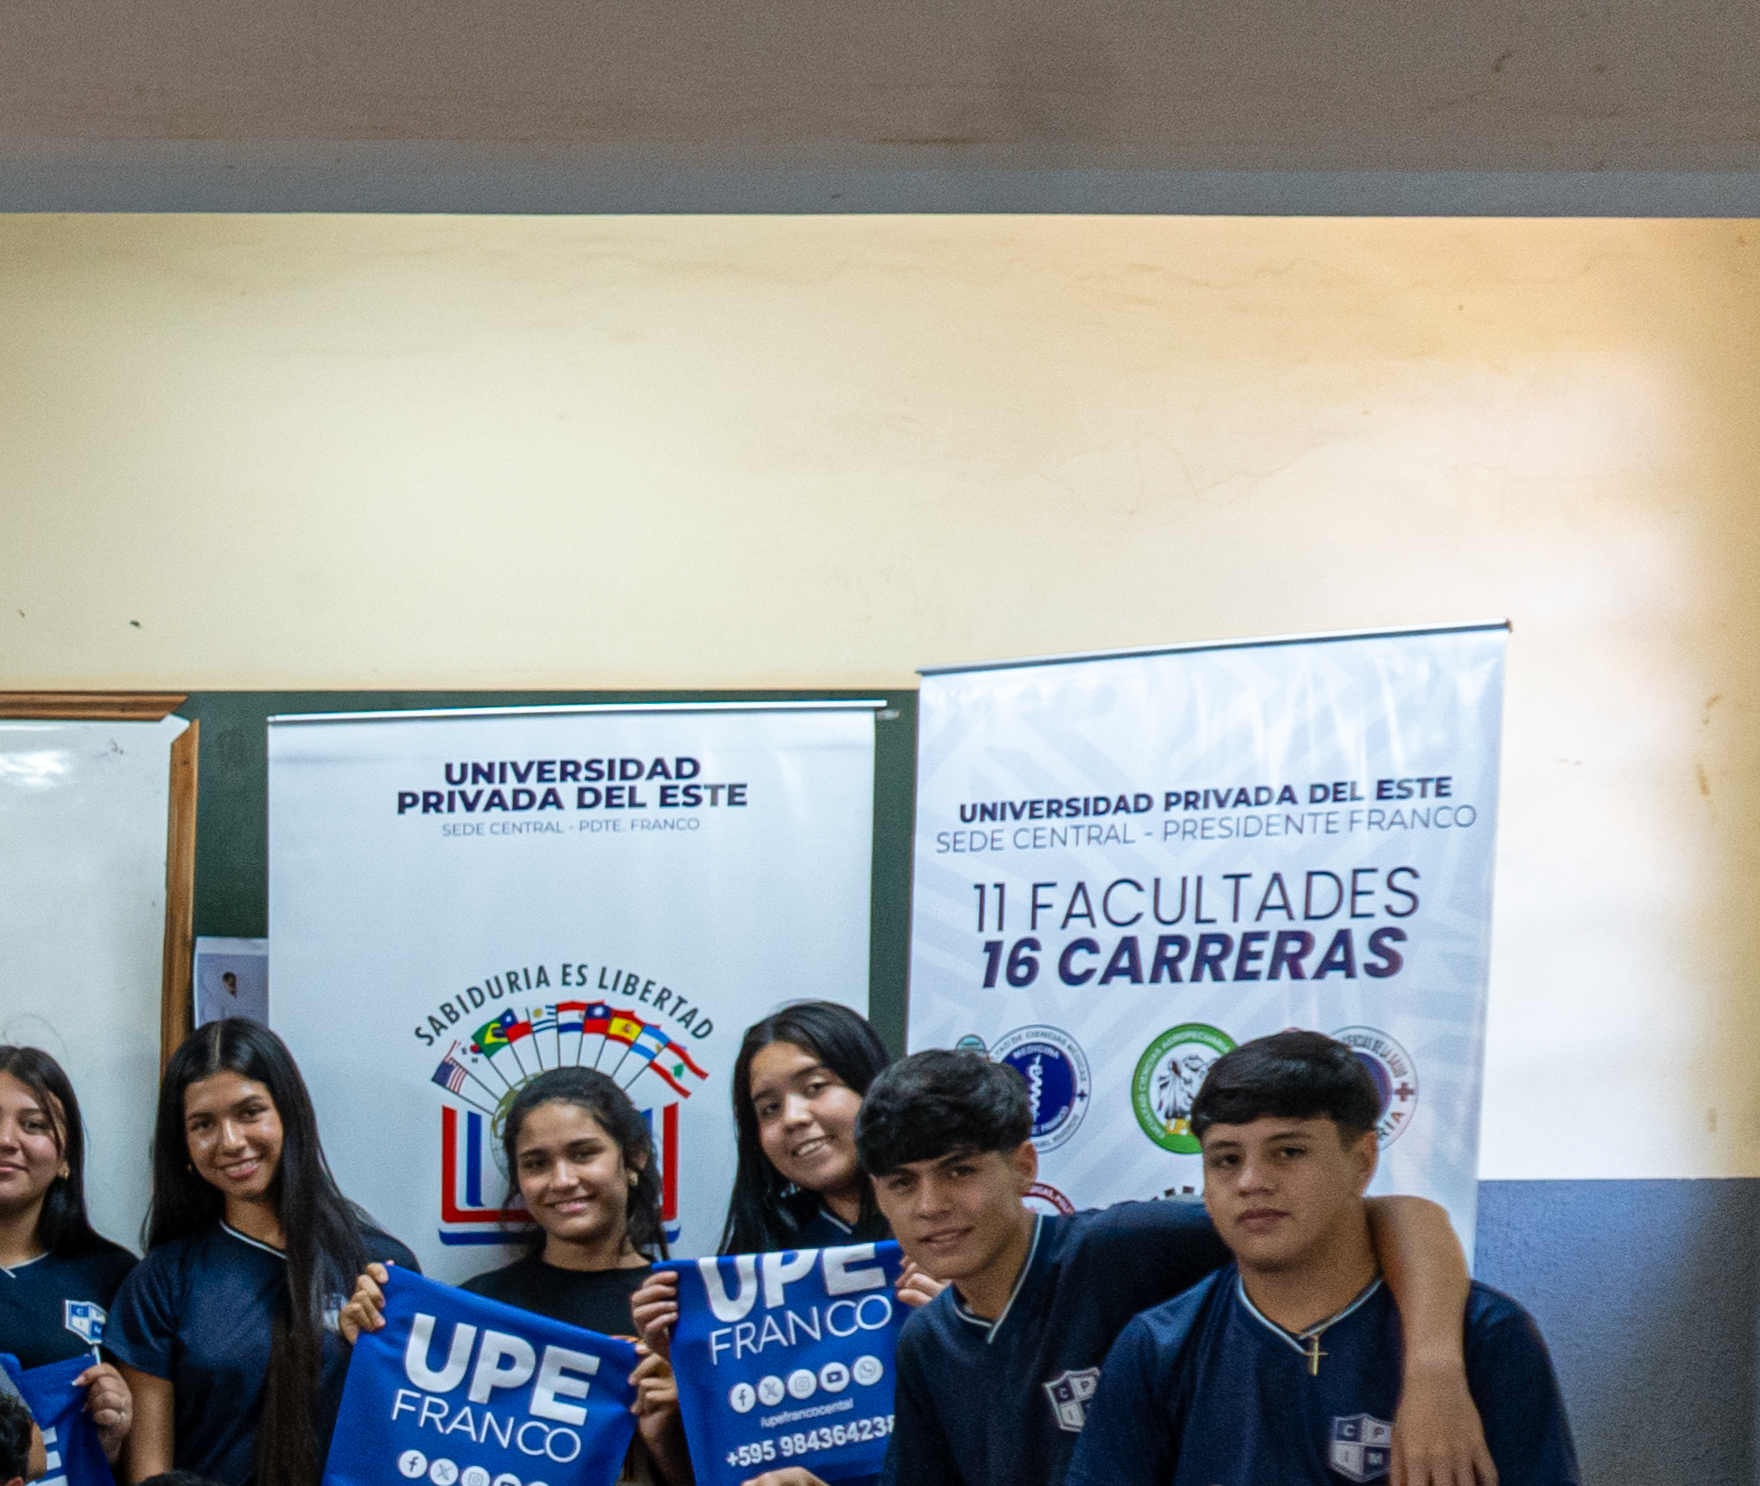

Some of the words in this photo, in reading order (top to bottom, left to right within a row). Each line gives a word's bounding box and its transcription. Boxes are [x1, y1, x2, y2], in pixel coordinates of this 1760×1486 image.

[397, 787, 565, 815] PRIVADA
[576, 785, 648, 810] DEL
[658, 783, 748, 808] ESTE
[444, 757, 701, 786] UNIVERSIDAD
[959, 792, 1154, 824] UNIVERSIDAD
[1164, 783, 1299, 813] PRIVADA
[1308, 780, 1364, 805] DEL
[1374, 776, 1453, 801] ESTE
[442, 823, 485, 837] SEDE
[490, 820, 564, 836] CENTRAL
[579, 818, 626, 833] PDTE.
[631, 817, 701, 832] FRANCO
[936, 829, 1004, 854] SEDE
[1013, 824, 1135, 850] CENTRAL
[1163, 810, 1340, 843] PRESIDENTE
[1349, 803, 1477, 832] FRANCO
[973, 882, 1006, 934] 11
[1030, 866, 1421, 931] FACULTADES
[981, 937, 1043, 988] 16
[1057, 926, 1409, 987] CARRERAS
[415, 965, 551, 1047] SABIDURIA
[561, 963, 588, 987] ES
[598, 966, 714, 1041] LIBERTAD
[698, 1243, 887, 1322] UPE
[710, 1294, 892, 1366] FRANCO
[403, 1312, 600, 1426] UPE
[392, 1388, 582, 1463] FRANCO
[727, 1440, 776, 1467] +595
